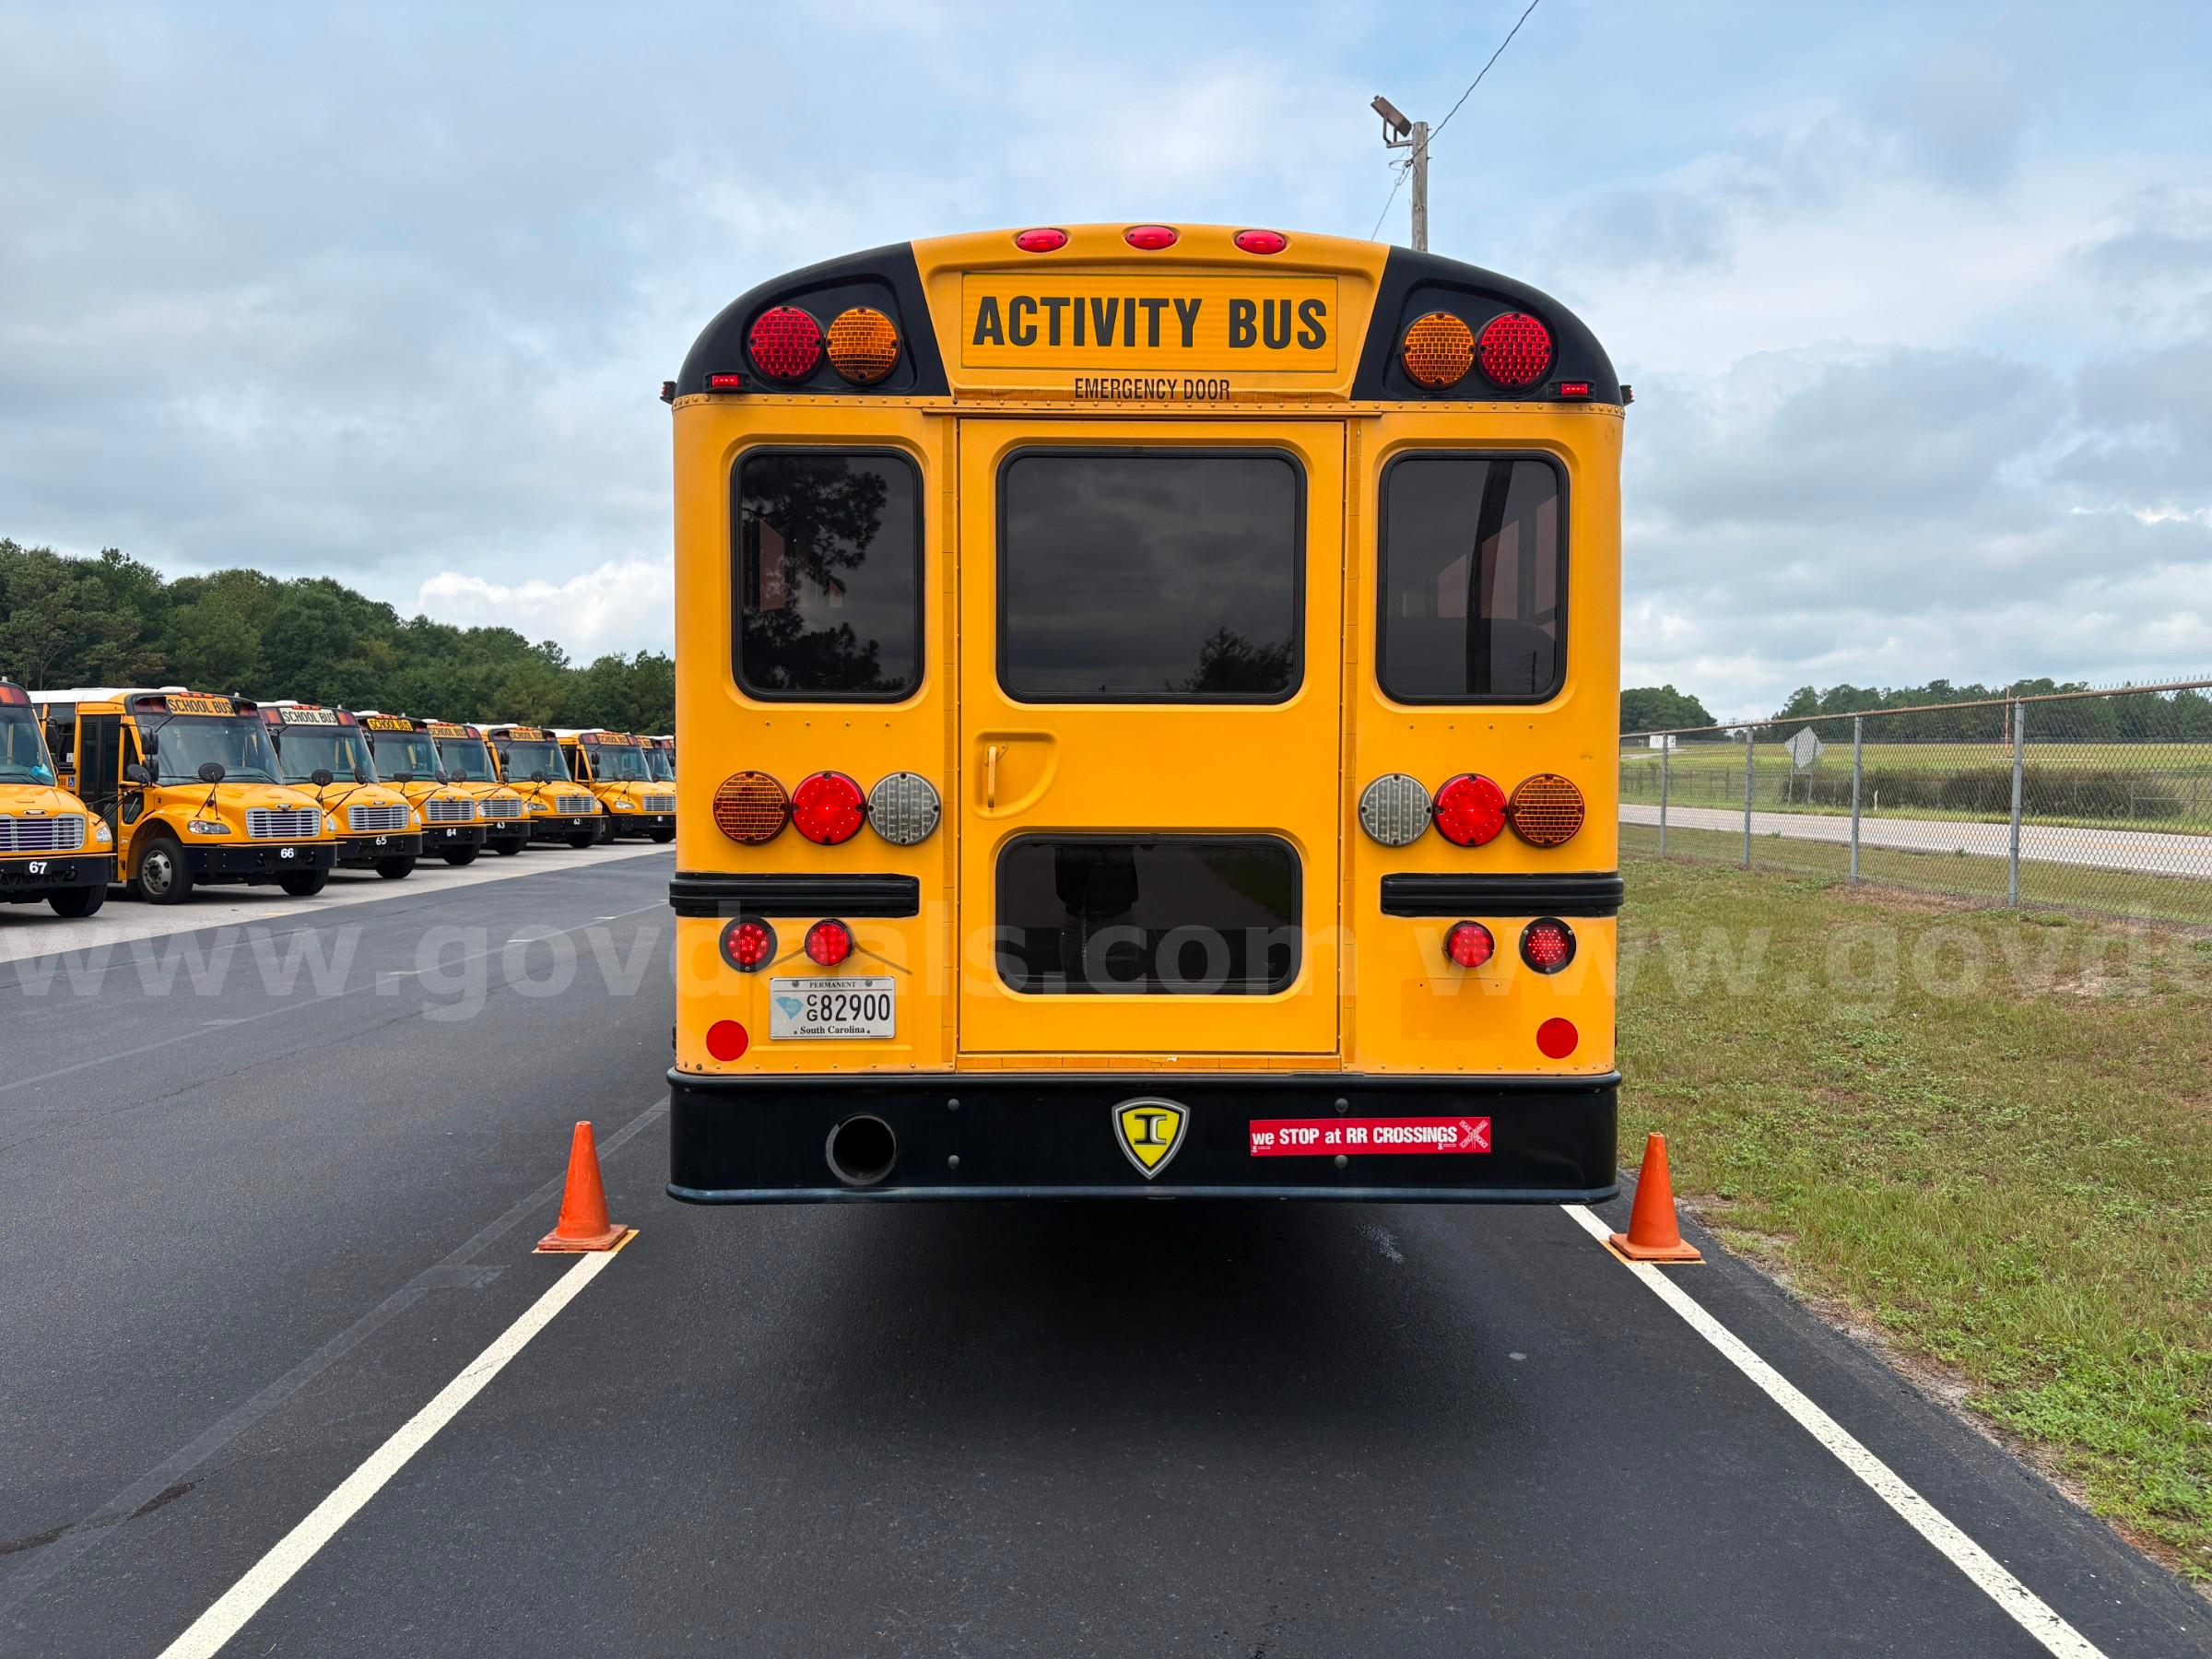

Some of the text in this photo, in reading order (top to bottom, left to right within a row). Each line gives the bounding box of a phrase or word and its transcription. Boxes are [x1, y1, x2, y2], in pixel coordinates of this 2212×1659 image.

[972, 295, 1328, 350] ACTIVITY BUS
[1075, 377, 1230, 401] EMERGENCY DOOR
[167, 699, 235, 714] SCHOOL BUS
[283, 711, 337, 724] SCHOOL BUS
[370, 718, 413, 731] SCHOOL BUS
[446, 829, 457, 837] 64
[375, 837, 387, 846] 65
[280, 848, 295, 859] 66
[29, 861, 48, 875] 67
[820, 994, 890, 1022] 82900
[800, 1026, 865, 1035] South Carolina
[1252, 1126, 1458, 1146] we STOP at RR CROSSINGS
